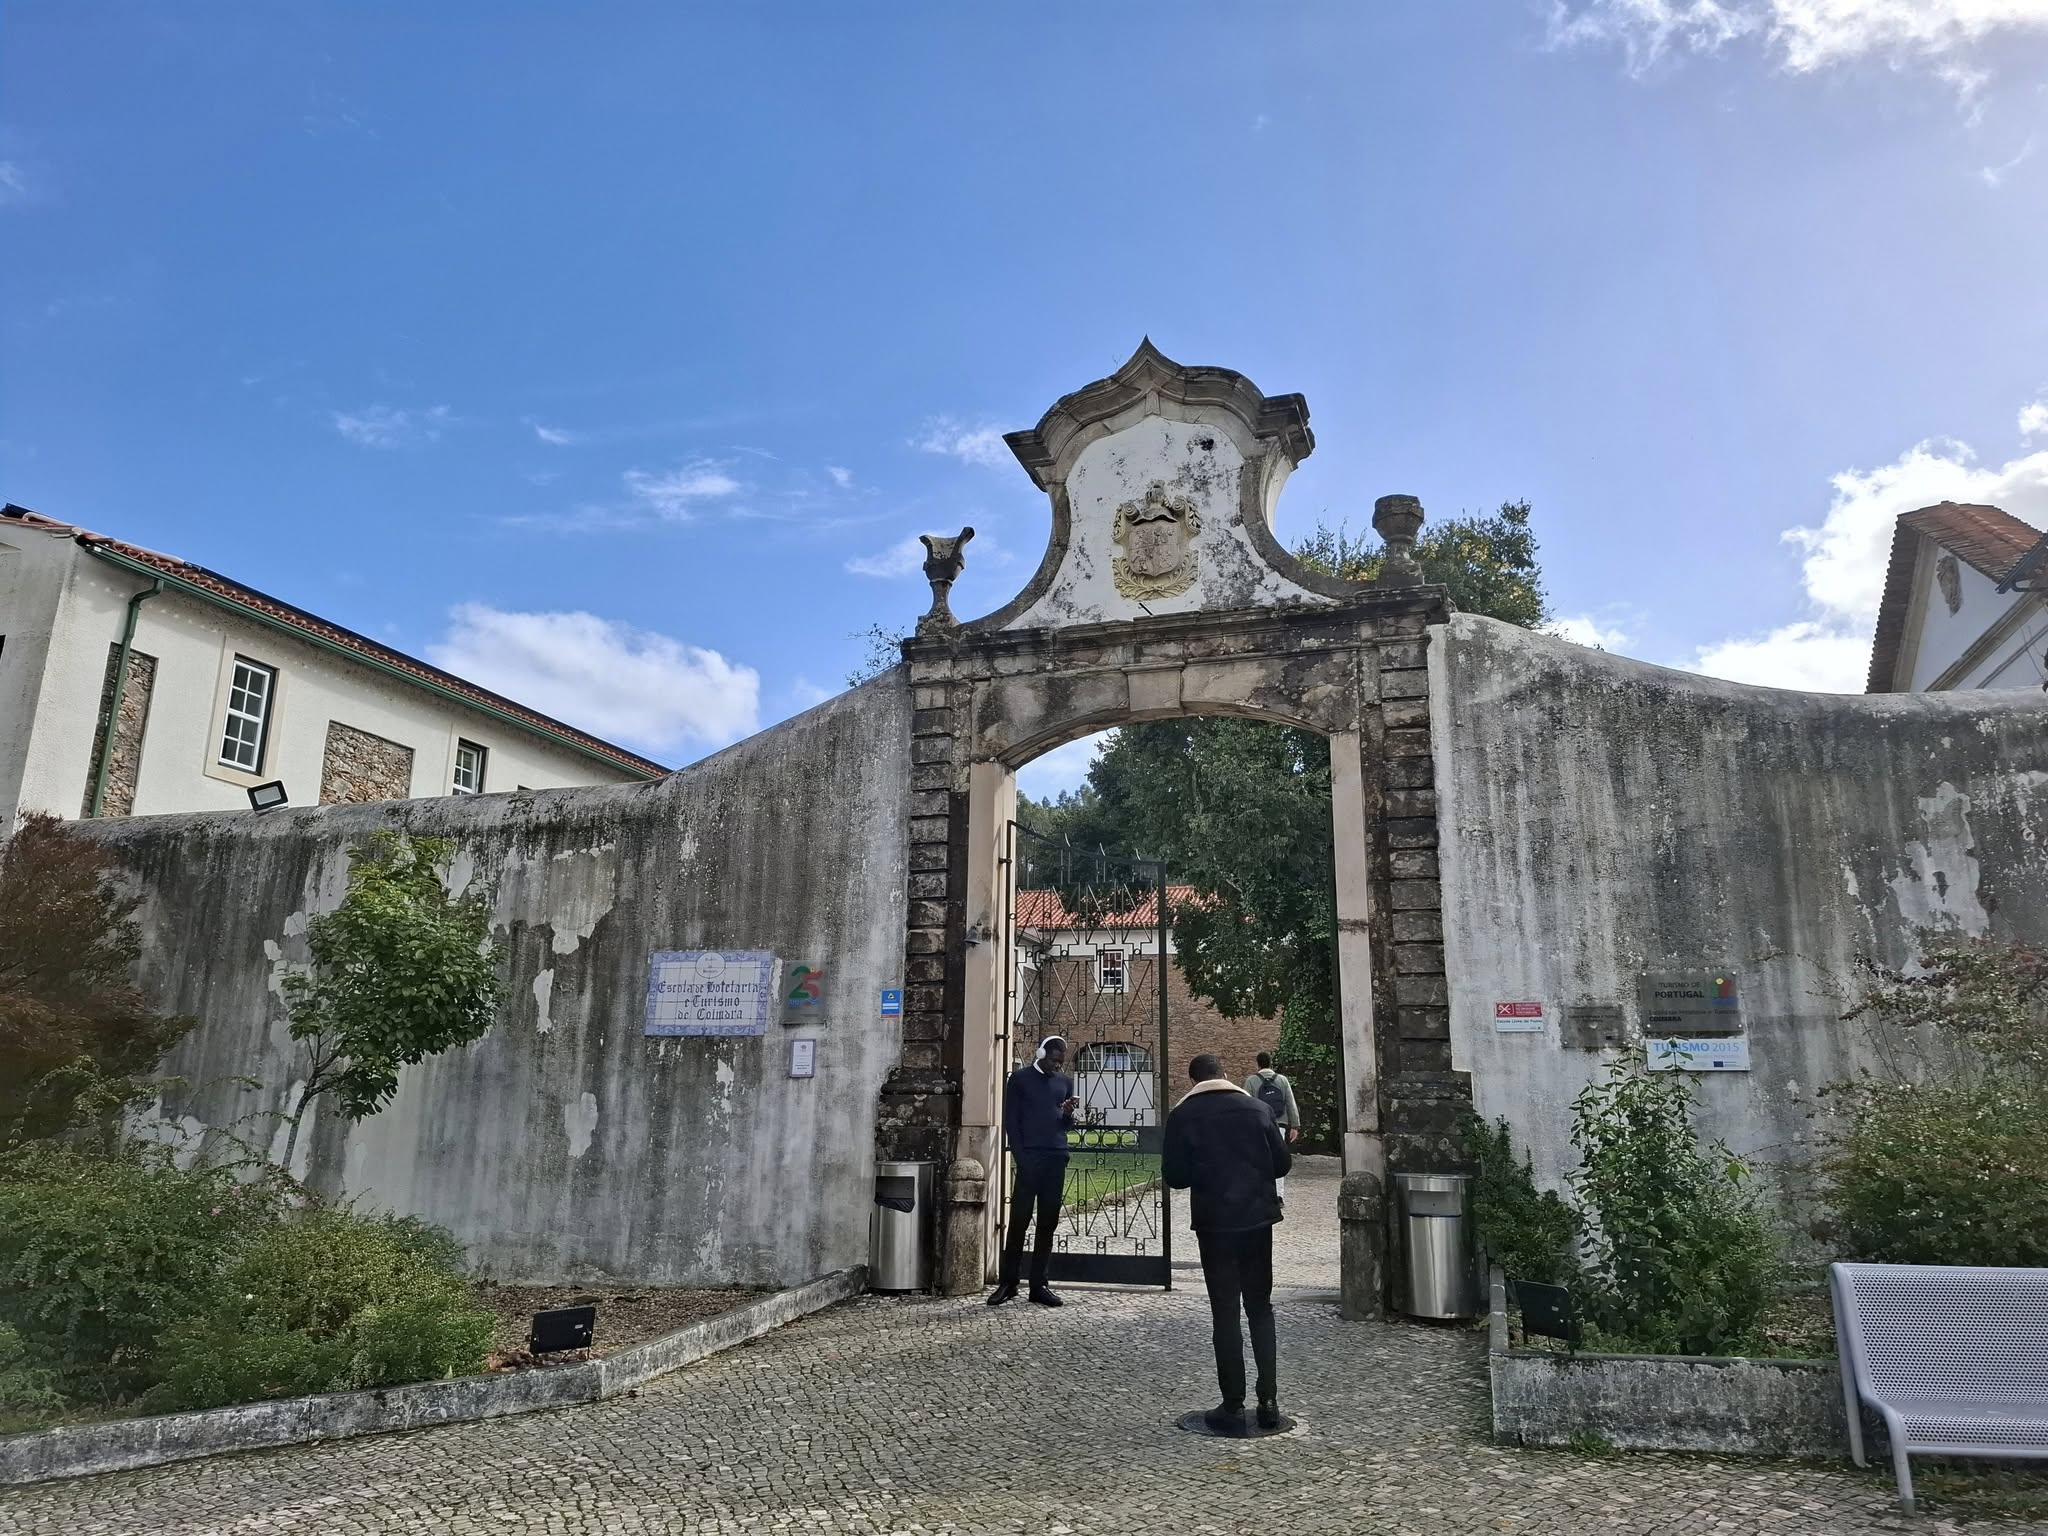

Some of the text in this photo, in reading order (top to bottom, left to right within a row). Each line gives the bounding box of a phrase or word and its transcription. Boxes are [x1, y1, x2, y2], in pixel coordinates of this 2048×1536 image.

[657, 979, 759, 994] Escola de Hotelaria
[692, 994, 740, 1008] Turismo
[1655, 990, 1705, 999] PORTUGAL
[677, 1007, 743, 1020] de Coimbra
[1653, 1042, 1740, 1052] TUISMO 2015
